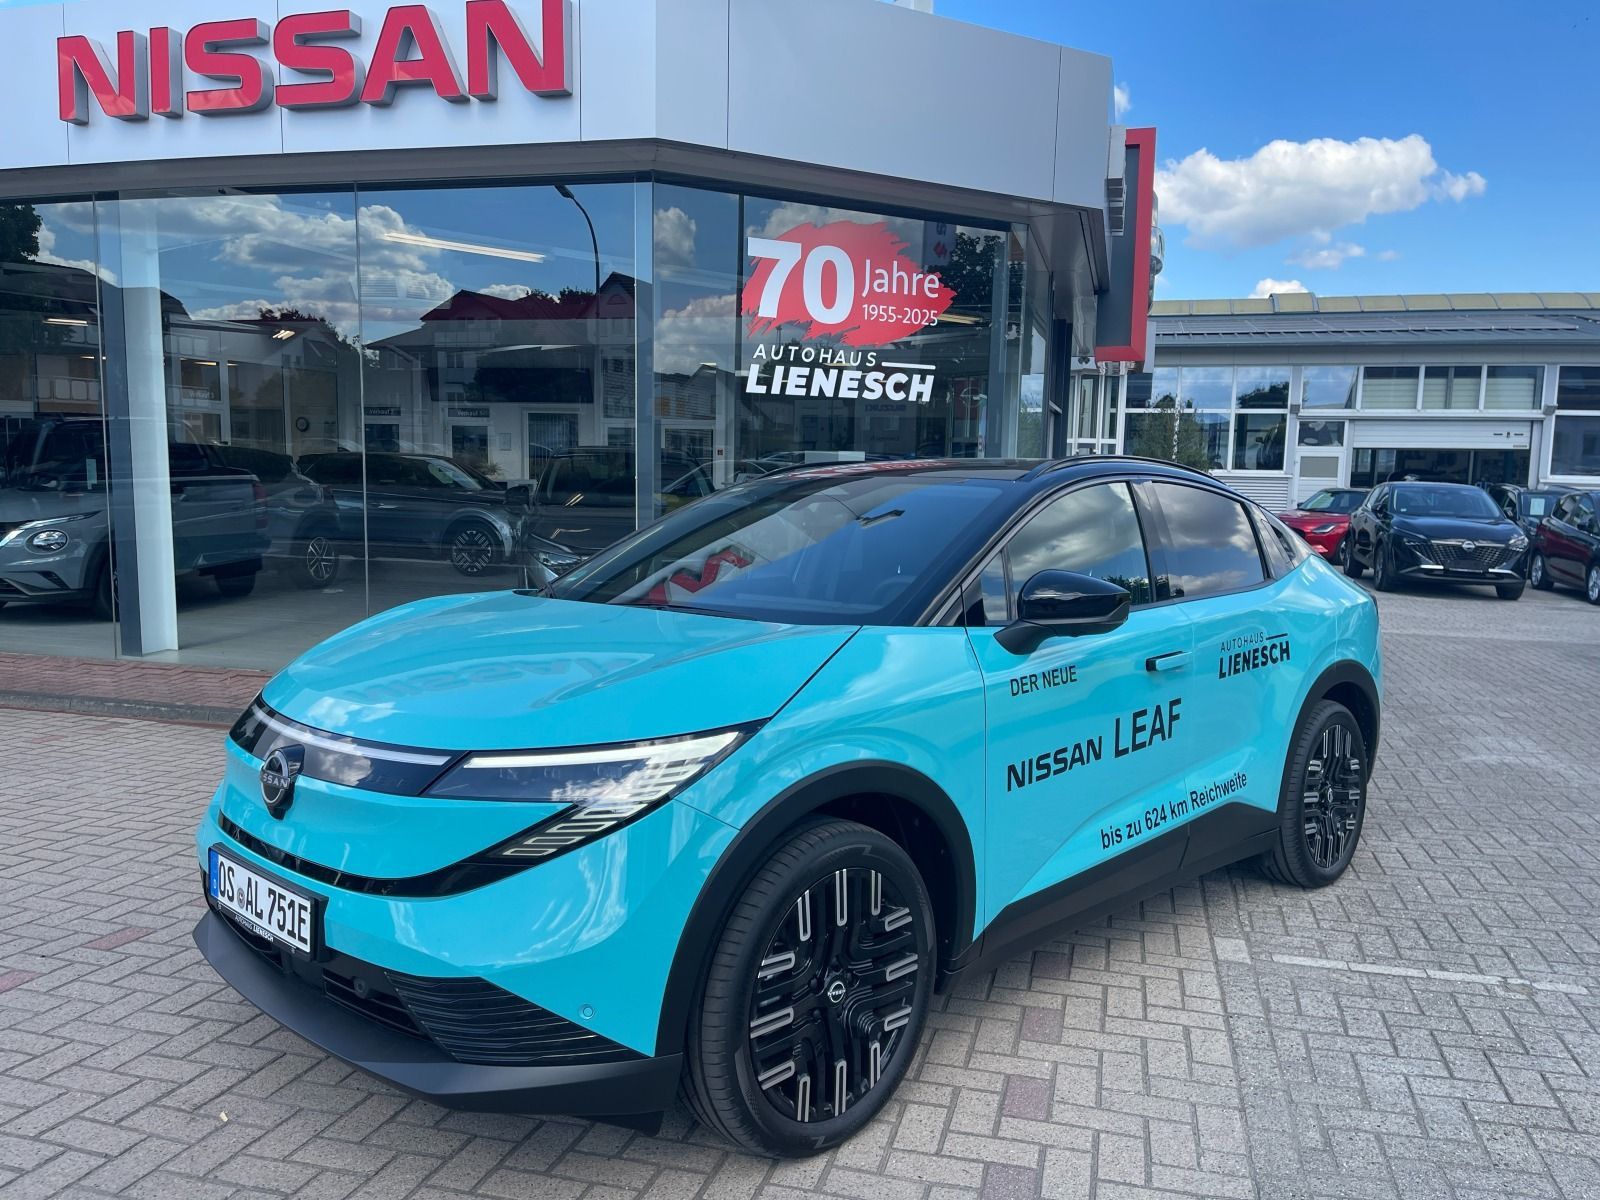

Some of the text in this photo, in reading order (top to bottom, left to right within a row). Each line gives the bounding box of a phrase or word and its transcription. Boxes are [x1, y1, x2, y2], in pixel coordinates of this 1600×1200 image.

[57, 0, 573, 125] NISSAN
[747, 236, 940, 325] 70 Jahre
[862, 304, 938, 326] 1955-2025
[753, 343, 877, 367] AUTOHAUS
[745, 363, 935, 402] LIENESCH
[1218, 640, 1291, 680] LIENESCH
[1220, 632, 1264, 653] AUTOHAUS
[1010, 665, 1078, 697] DER NEUE
[1007, 697, 1182, 792] NISSAN LEAF
[263, 773, 289, 788] SSAN
[1101, 772, 1248, 850] bis zu 624 km Reichweite
[219, 860, 308, 946] OS AL 751E
